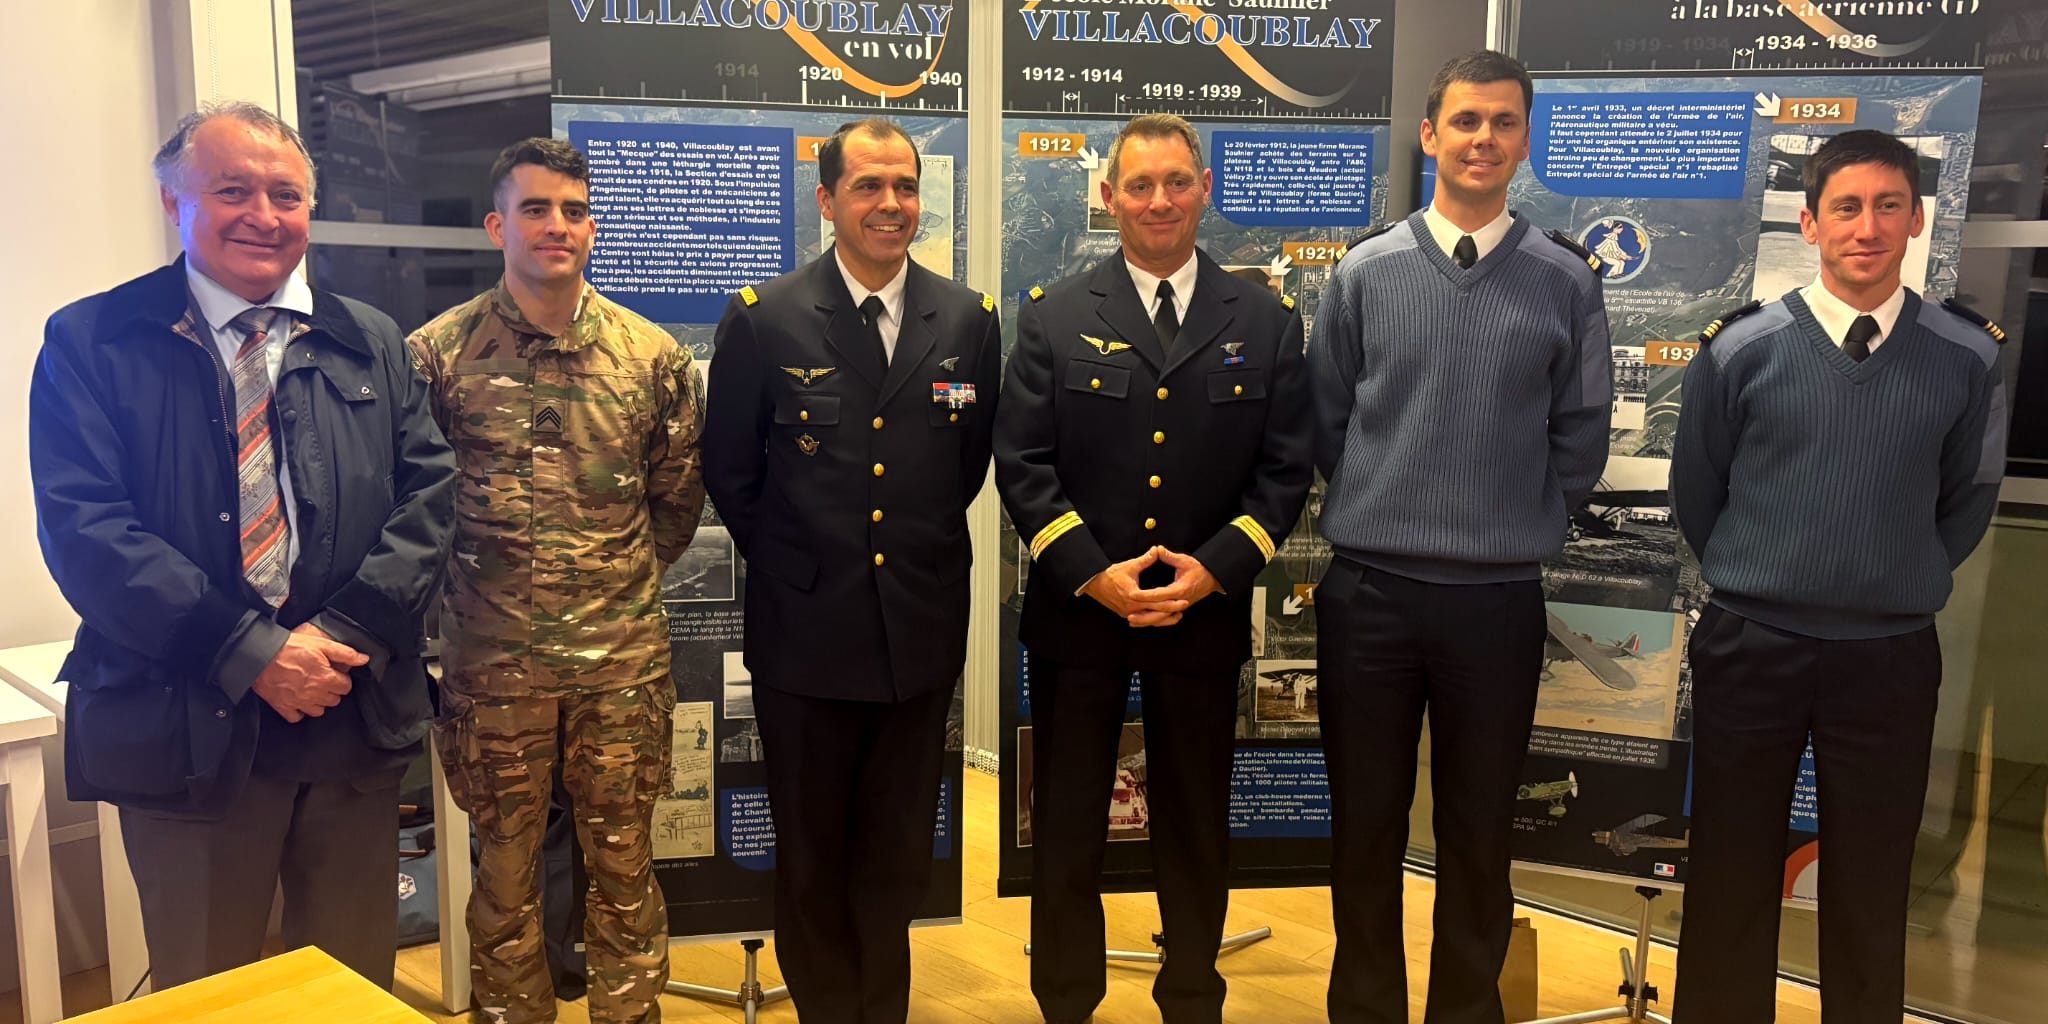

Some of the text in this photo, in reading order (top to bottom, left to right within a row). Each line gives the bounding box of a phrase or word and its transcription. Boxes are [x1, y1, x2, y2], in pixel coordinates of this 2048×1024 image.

[1695, 0, 1718, 18] la
[1727, 0, 1791, 18] base
[571, 0, 953, 37] VILLACOUBLAY
[1018, 9, 1381, 48] VILLACOUBLAY
[844, 37, 932, 60] en vol
[1754, 35, 1806, 50] 1934
[1826, 34, 1878, 50] 1936
[714, 62, 760, 78] 1914
[799, 65, 843, 81] 1920
[1022, 67, 1064, 81] 1912
[1081, 68, 1123, 83] 1914
[920, 71, 962, 87] 1940
[1142, 83, 1184, 98] 1919
[1200, 84, 1242, 98] 1939
[1790, 104, 1841, 118] 1934
[682, 142, 734, 152] Villacoublay
[1030, 137, 1072, 152] 1912
[733, 153, 757, 162] Après
[1592, 164, 1631, 172] l'Entrepôt
[1697, 164, 1738, 172] rebaptisé
[589, 204, 610, 213] vingt
[739, 207, 780, 216] s'imposer,
[1296, 247, 1335, 260] 1921
[729, 261, 781, 269] progressent.
[1658, 346, 1698, 360] 193
